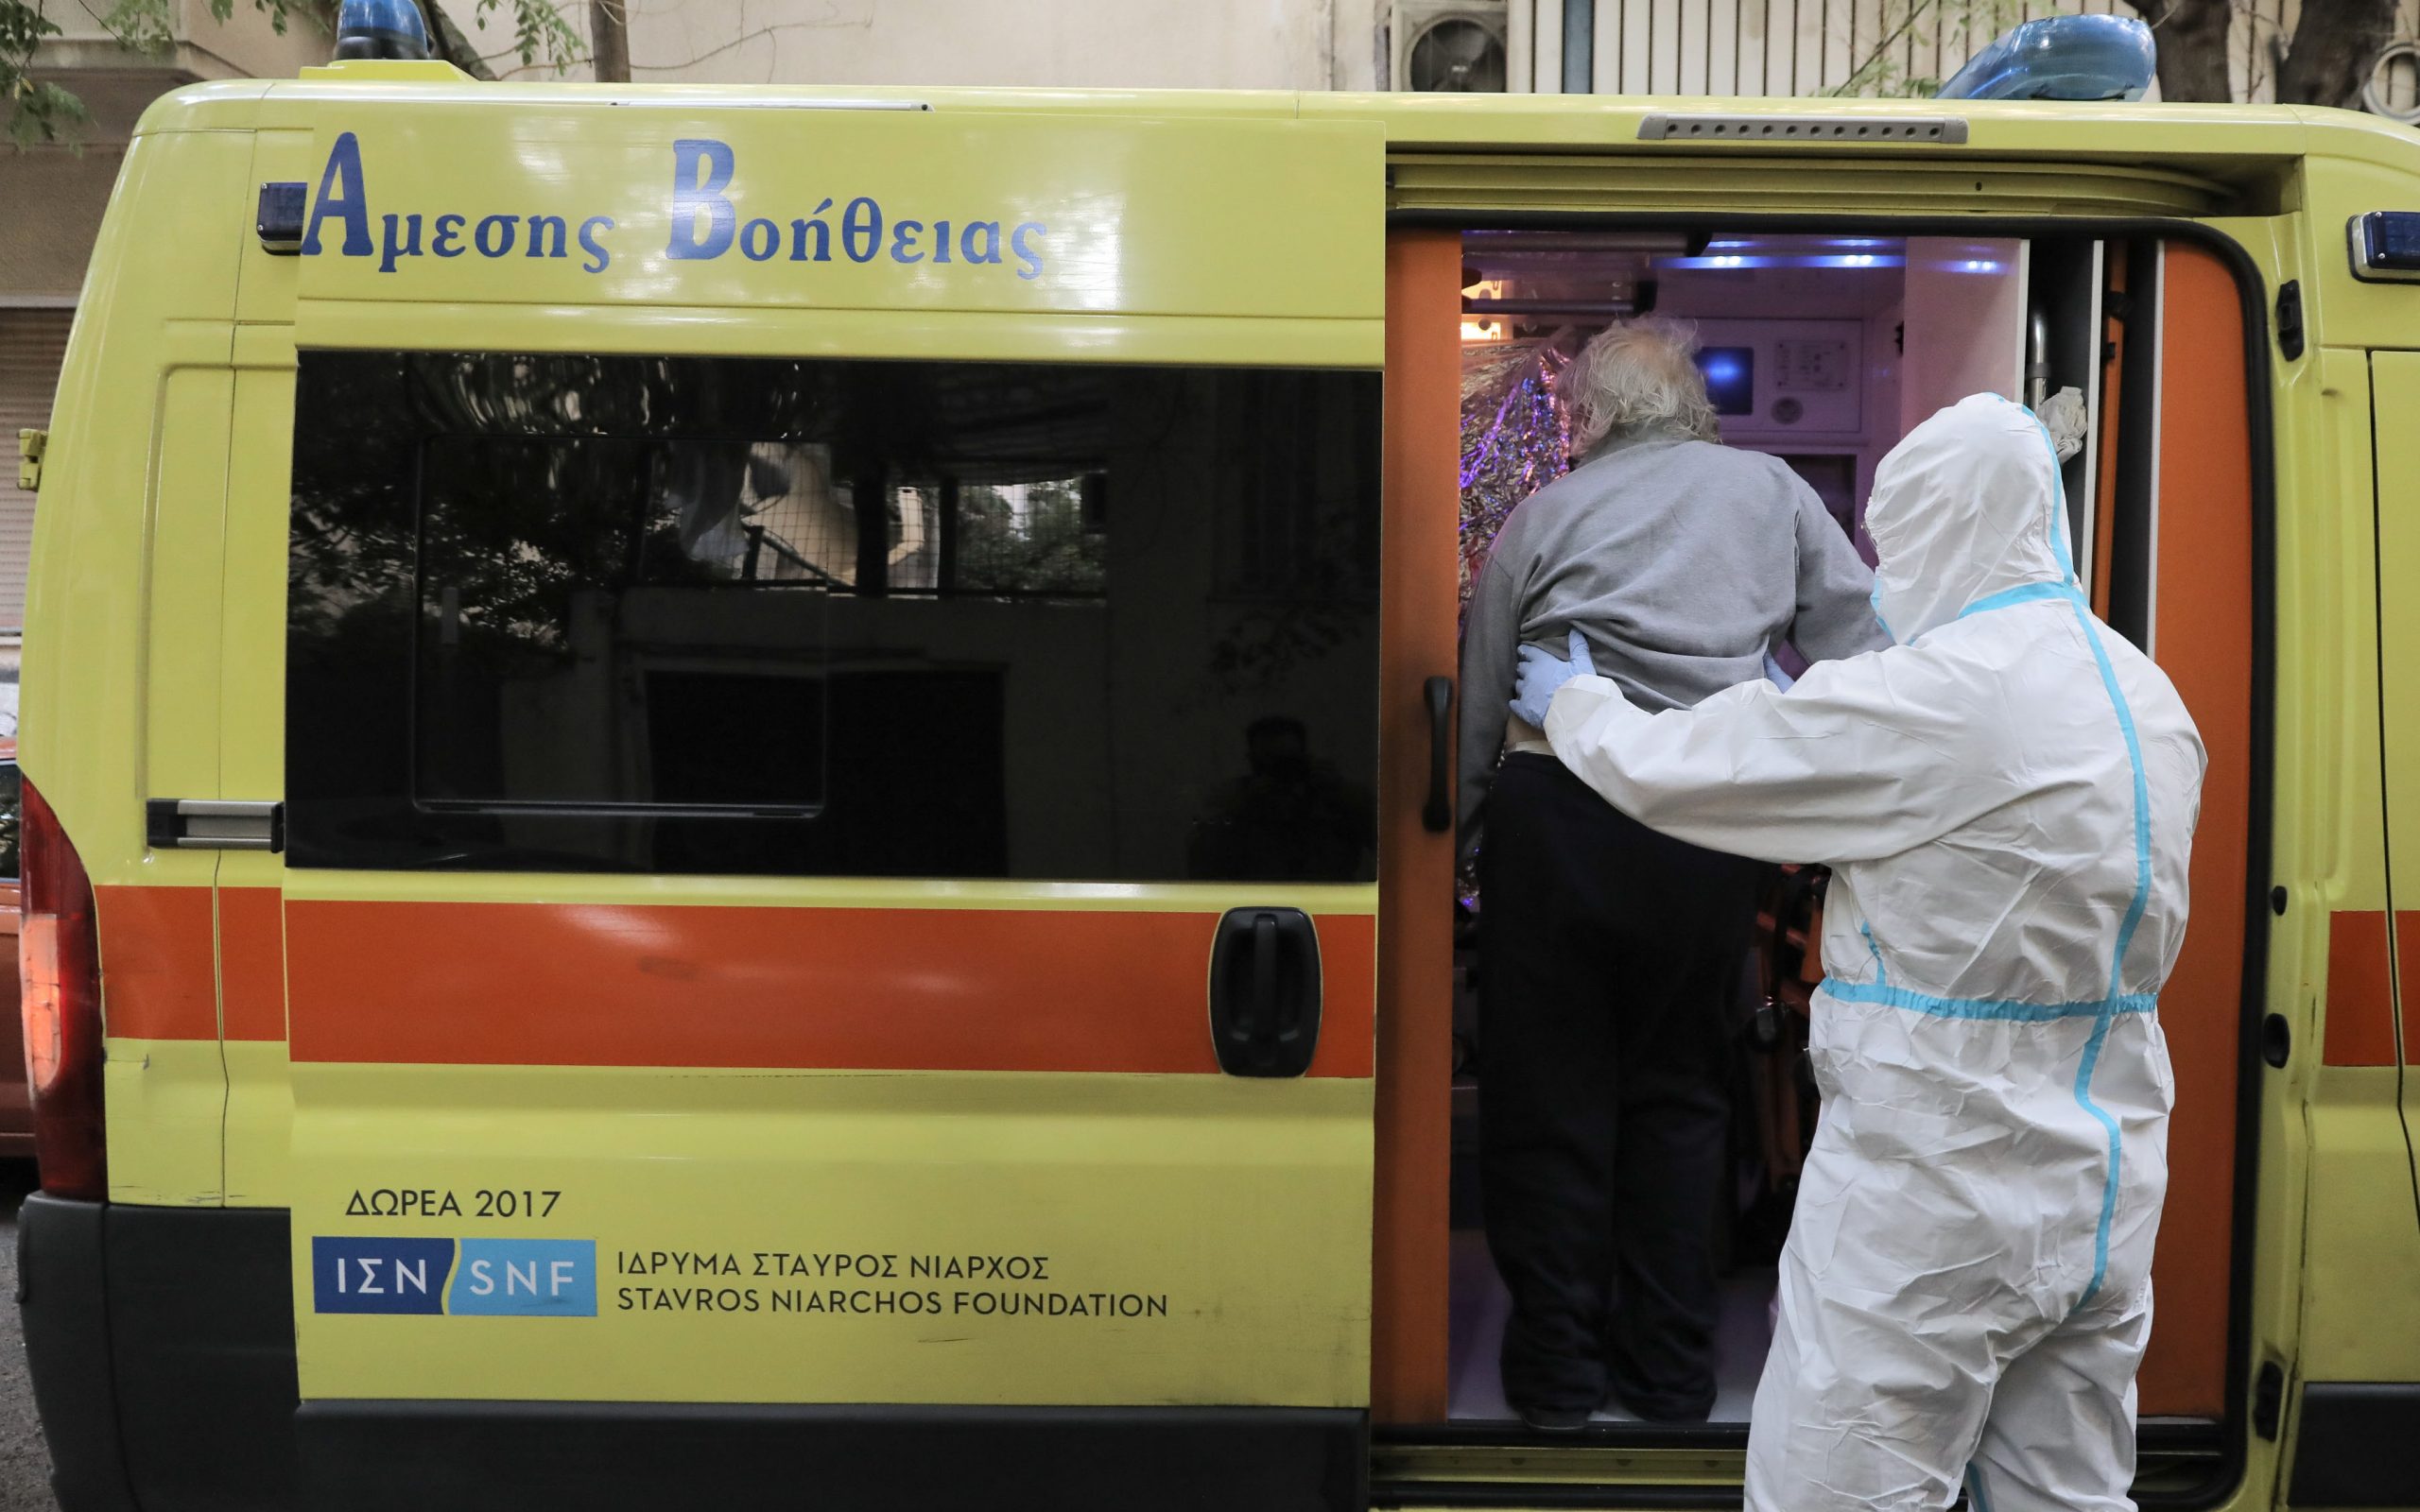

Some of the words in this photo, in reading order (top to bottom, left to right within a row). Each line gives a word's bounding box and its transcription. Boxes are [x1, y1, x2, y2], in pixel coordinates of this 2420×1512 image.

[300, 131, 615, 273] Αμεσης
[666, 138, 1047, 281] Βοήθειας
[345, 1189, 462, 1217] ΔΩΡΕΑ
[475, 1189, 562, 1218] 2017
[337, 1258, 426, 1295] ΙΣΝ
[470, 1260, 575, 1297] SNF
[618, 1250, 742, 1276] ΙΔΡΥΜΑ
[752, 1252, 898, 1279] ΣΤΑΥΡΟΣ
[910, 1255, 1049, 1280] ΝΙΑΡΧΟΣ
[617, 1287, 760, 1313] STAVROS
[771, 1289, 942, 1315] NIARCHOS
[953, 1291, 1167, 1318] FOUNDATION
